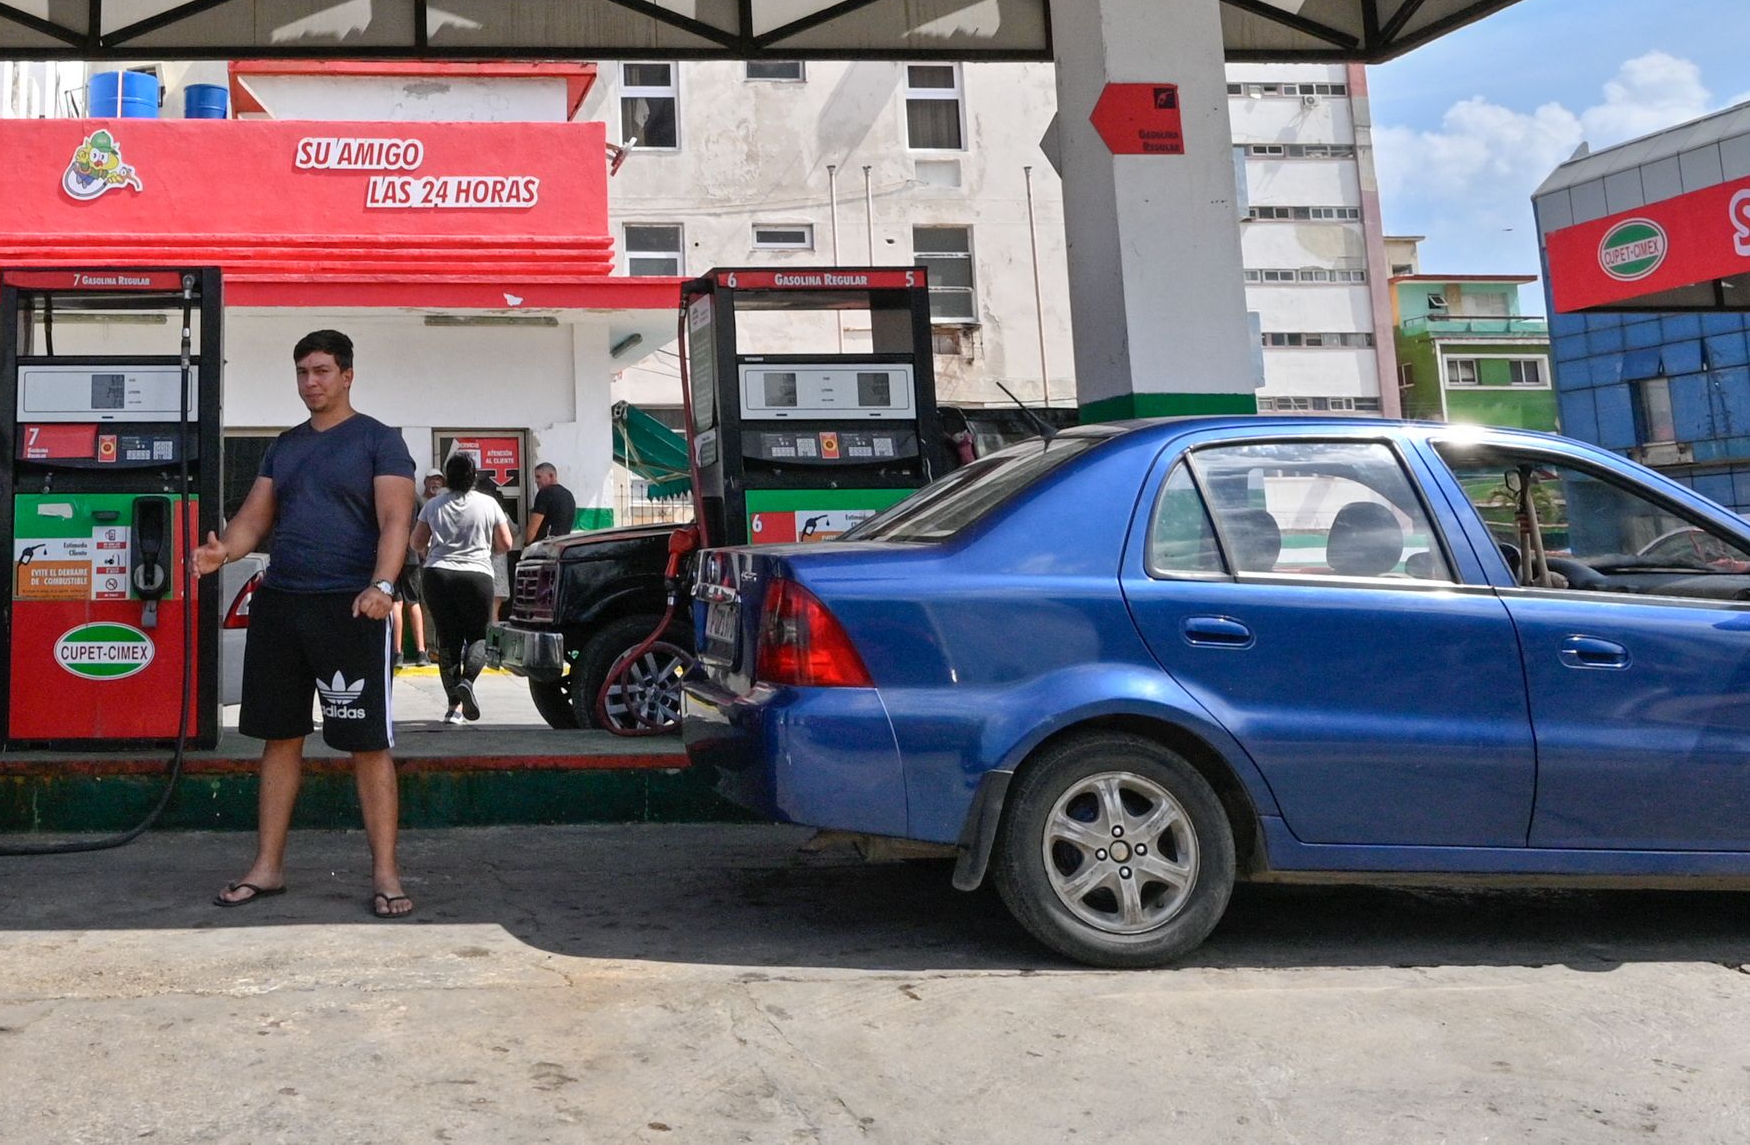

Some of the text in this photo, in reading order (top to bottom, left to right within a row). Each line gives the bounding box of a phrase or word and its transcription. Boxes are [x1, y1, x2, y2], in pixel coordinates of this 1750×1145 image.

[299, 141, 420, 167] SU AMIGO
[369, 178, 538, 204] LAS 24 HORAS
[1603, 238, 1660, 266] CUPET-CIMEX
[73, 273, 151, 287] 7 GASOLINA REGULAR
[727, 271, 915, 288] 6 GASOLINA REGULAR 5
[28, 427, 40, 446] 7
[751, 513, 763, 533] 6
[30, 568, 48, 577] EVITE
[49, 568, 57, 577] EL
[30, 577, 88, 586] DE COMBUSTIBLE
[60, 645, 148, 661] CUPET-CIMEX
